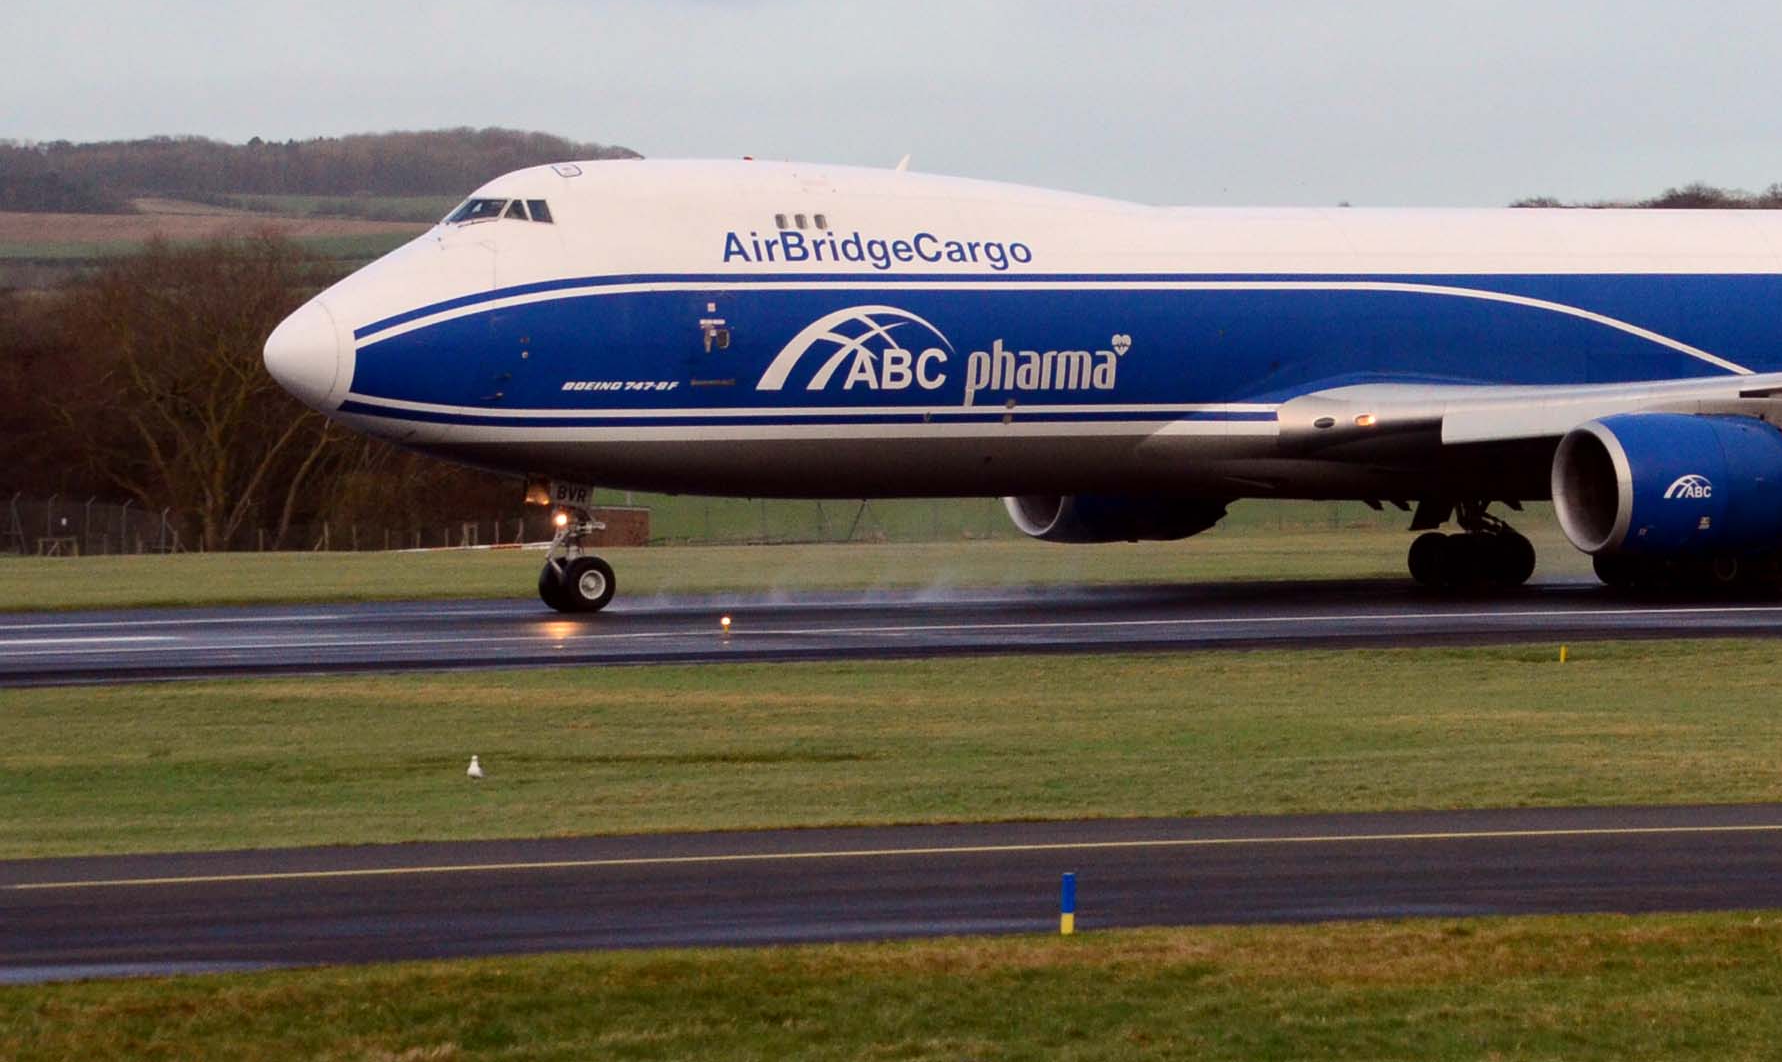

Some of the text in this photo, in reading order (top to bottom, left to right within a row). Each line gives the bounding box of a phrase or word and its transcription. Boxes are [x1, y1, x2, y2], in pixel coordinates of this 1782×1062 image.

[722, 231, 1033, 270] AirBridgeCargo
[842, 338, 1117, 407] ABC pharma
[624, 381, 680, 391] 747-8F
[556, 484, 587, 503] BVR
[1685, 485, 1712, 499] ABC
